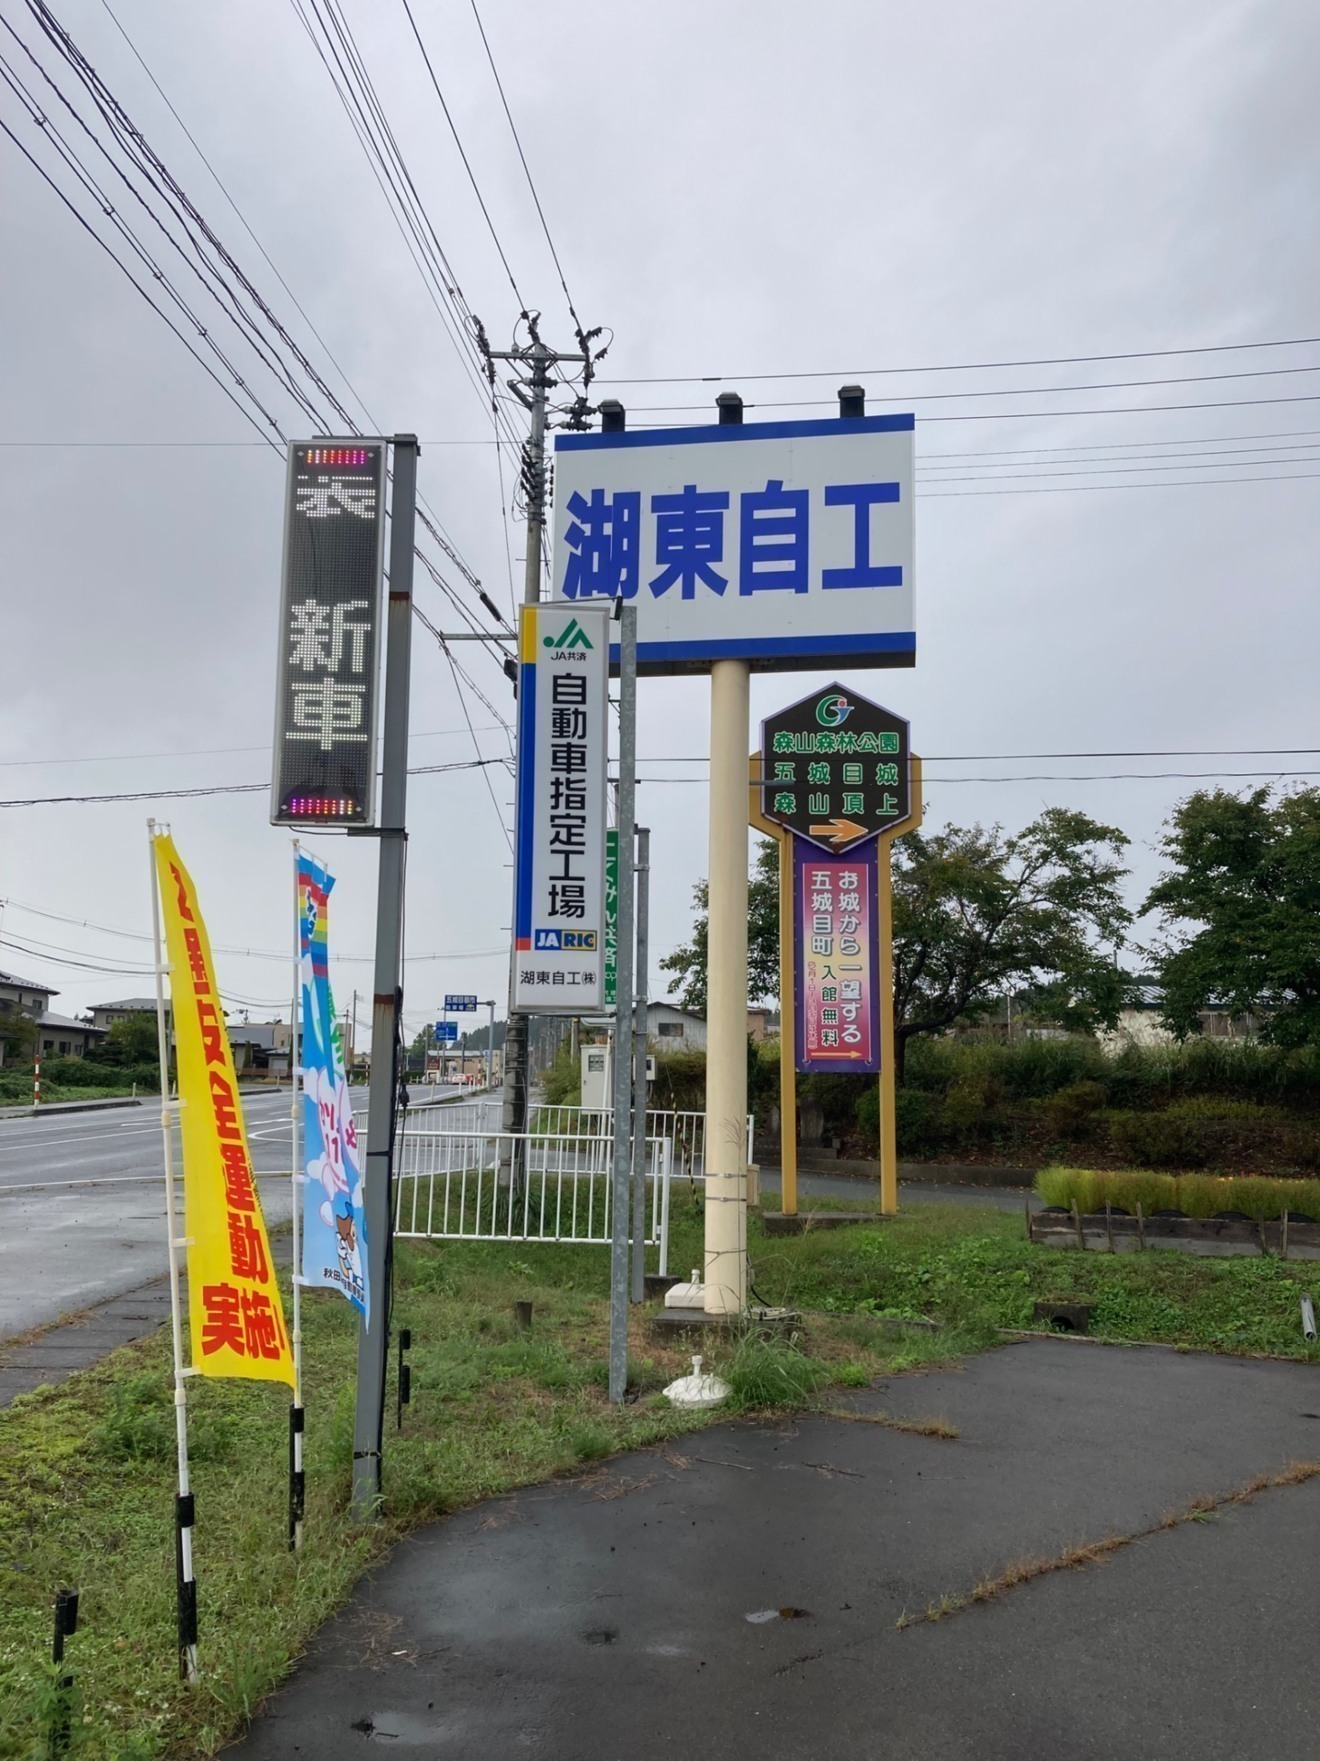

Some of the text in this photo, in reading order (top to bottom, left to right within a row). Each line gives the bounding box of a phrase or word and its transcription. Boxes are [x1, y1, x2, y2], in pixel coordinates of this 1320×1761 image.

[562, 480, 903, 601] 湖東自工
[285, 599, 371, 750] 新車
[550, 651, 587, 661] JA共済
[772, 731, 900, 753] 森山森林公園
[773, 762, 899, 785] 五城目城
[547, 673, 587, 919] 自動車指定工場
[773, 792, 899, 815] 森山頂上
[811, 871, 834, 956] 五城目町
[838, 870, 862, 1044] お城から一望する
[821, 965, 839, 1047] 入館無料
